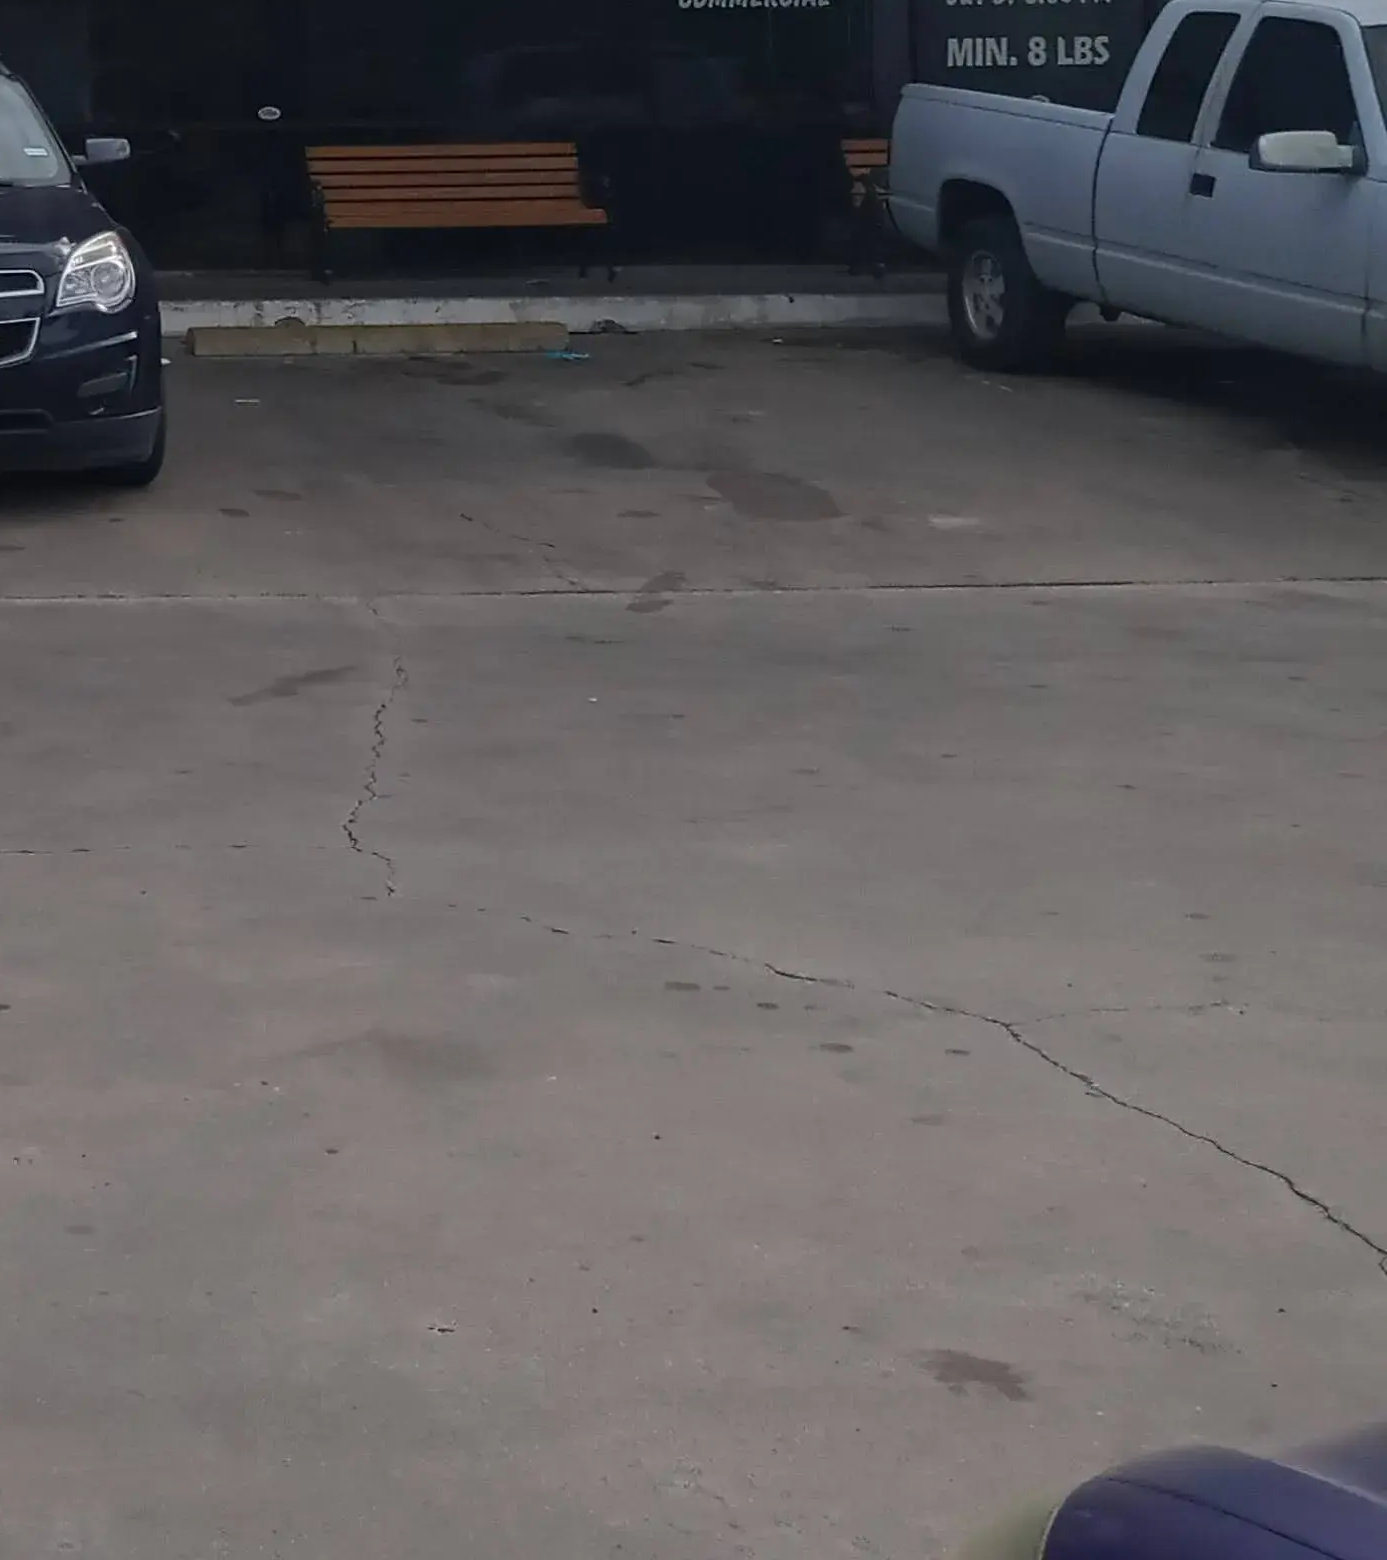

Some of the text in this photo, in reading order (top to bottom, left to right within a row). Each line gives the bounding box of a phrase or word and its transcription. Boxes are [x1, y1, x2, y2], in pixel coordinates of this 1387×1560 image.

[947, 35, 1110, 68] MIN. 8 LBS
